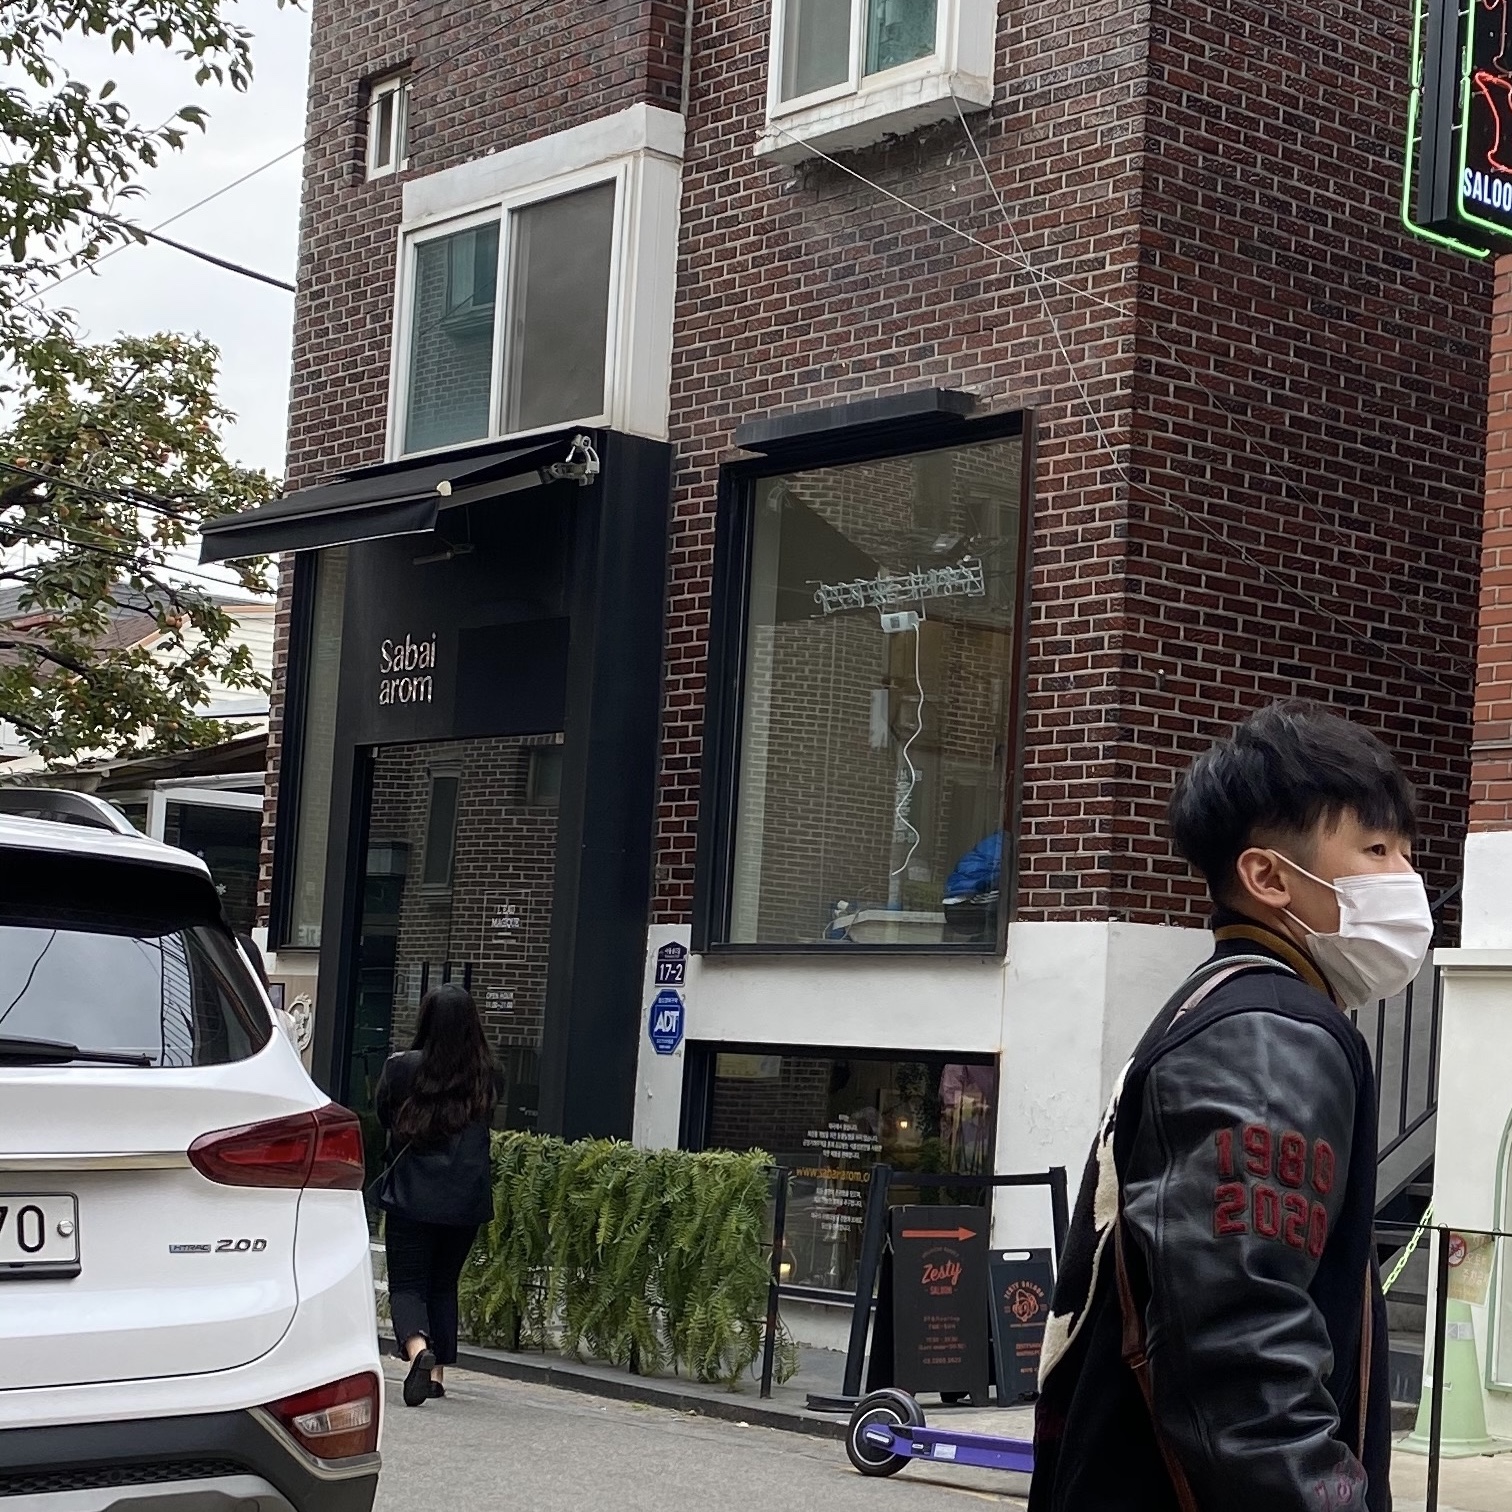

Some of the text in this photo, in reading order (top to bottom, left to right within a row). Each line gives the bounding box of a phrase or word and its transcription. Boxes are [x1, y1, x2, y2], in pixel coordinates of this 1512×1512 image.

[380, 632, 437, 674] Sabai
[378, 673, 433, 705] arom
[660, 964, 683, 980] 17-2
[654, 1010, 680, 1033] ADT
[1214, 1123, 1336, 1196] 1980
[1212, 1181, 1328, 1260] 2020
[171, 1244, 210, 1253] HTRAC
[921, 1259, 962, 1286] Zesty
